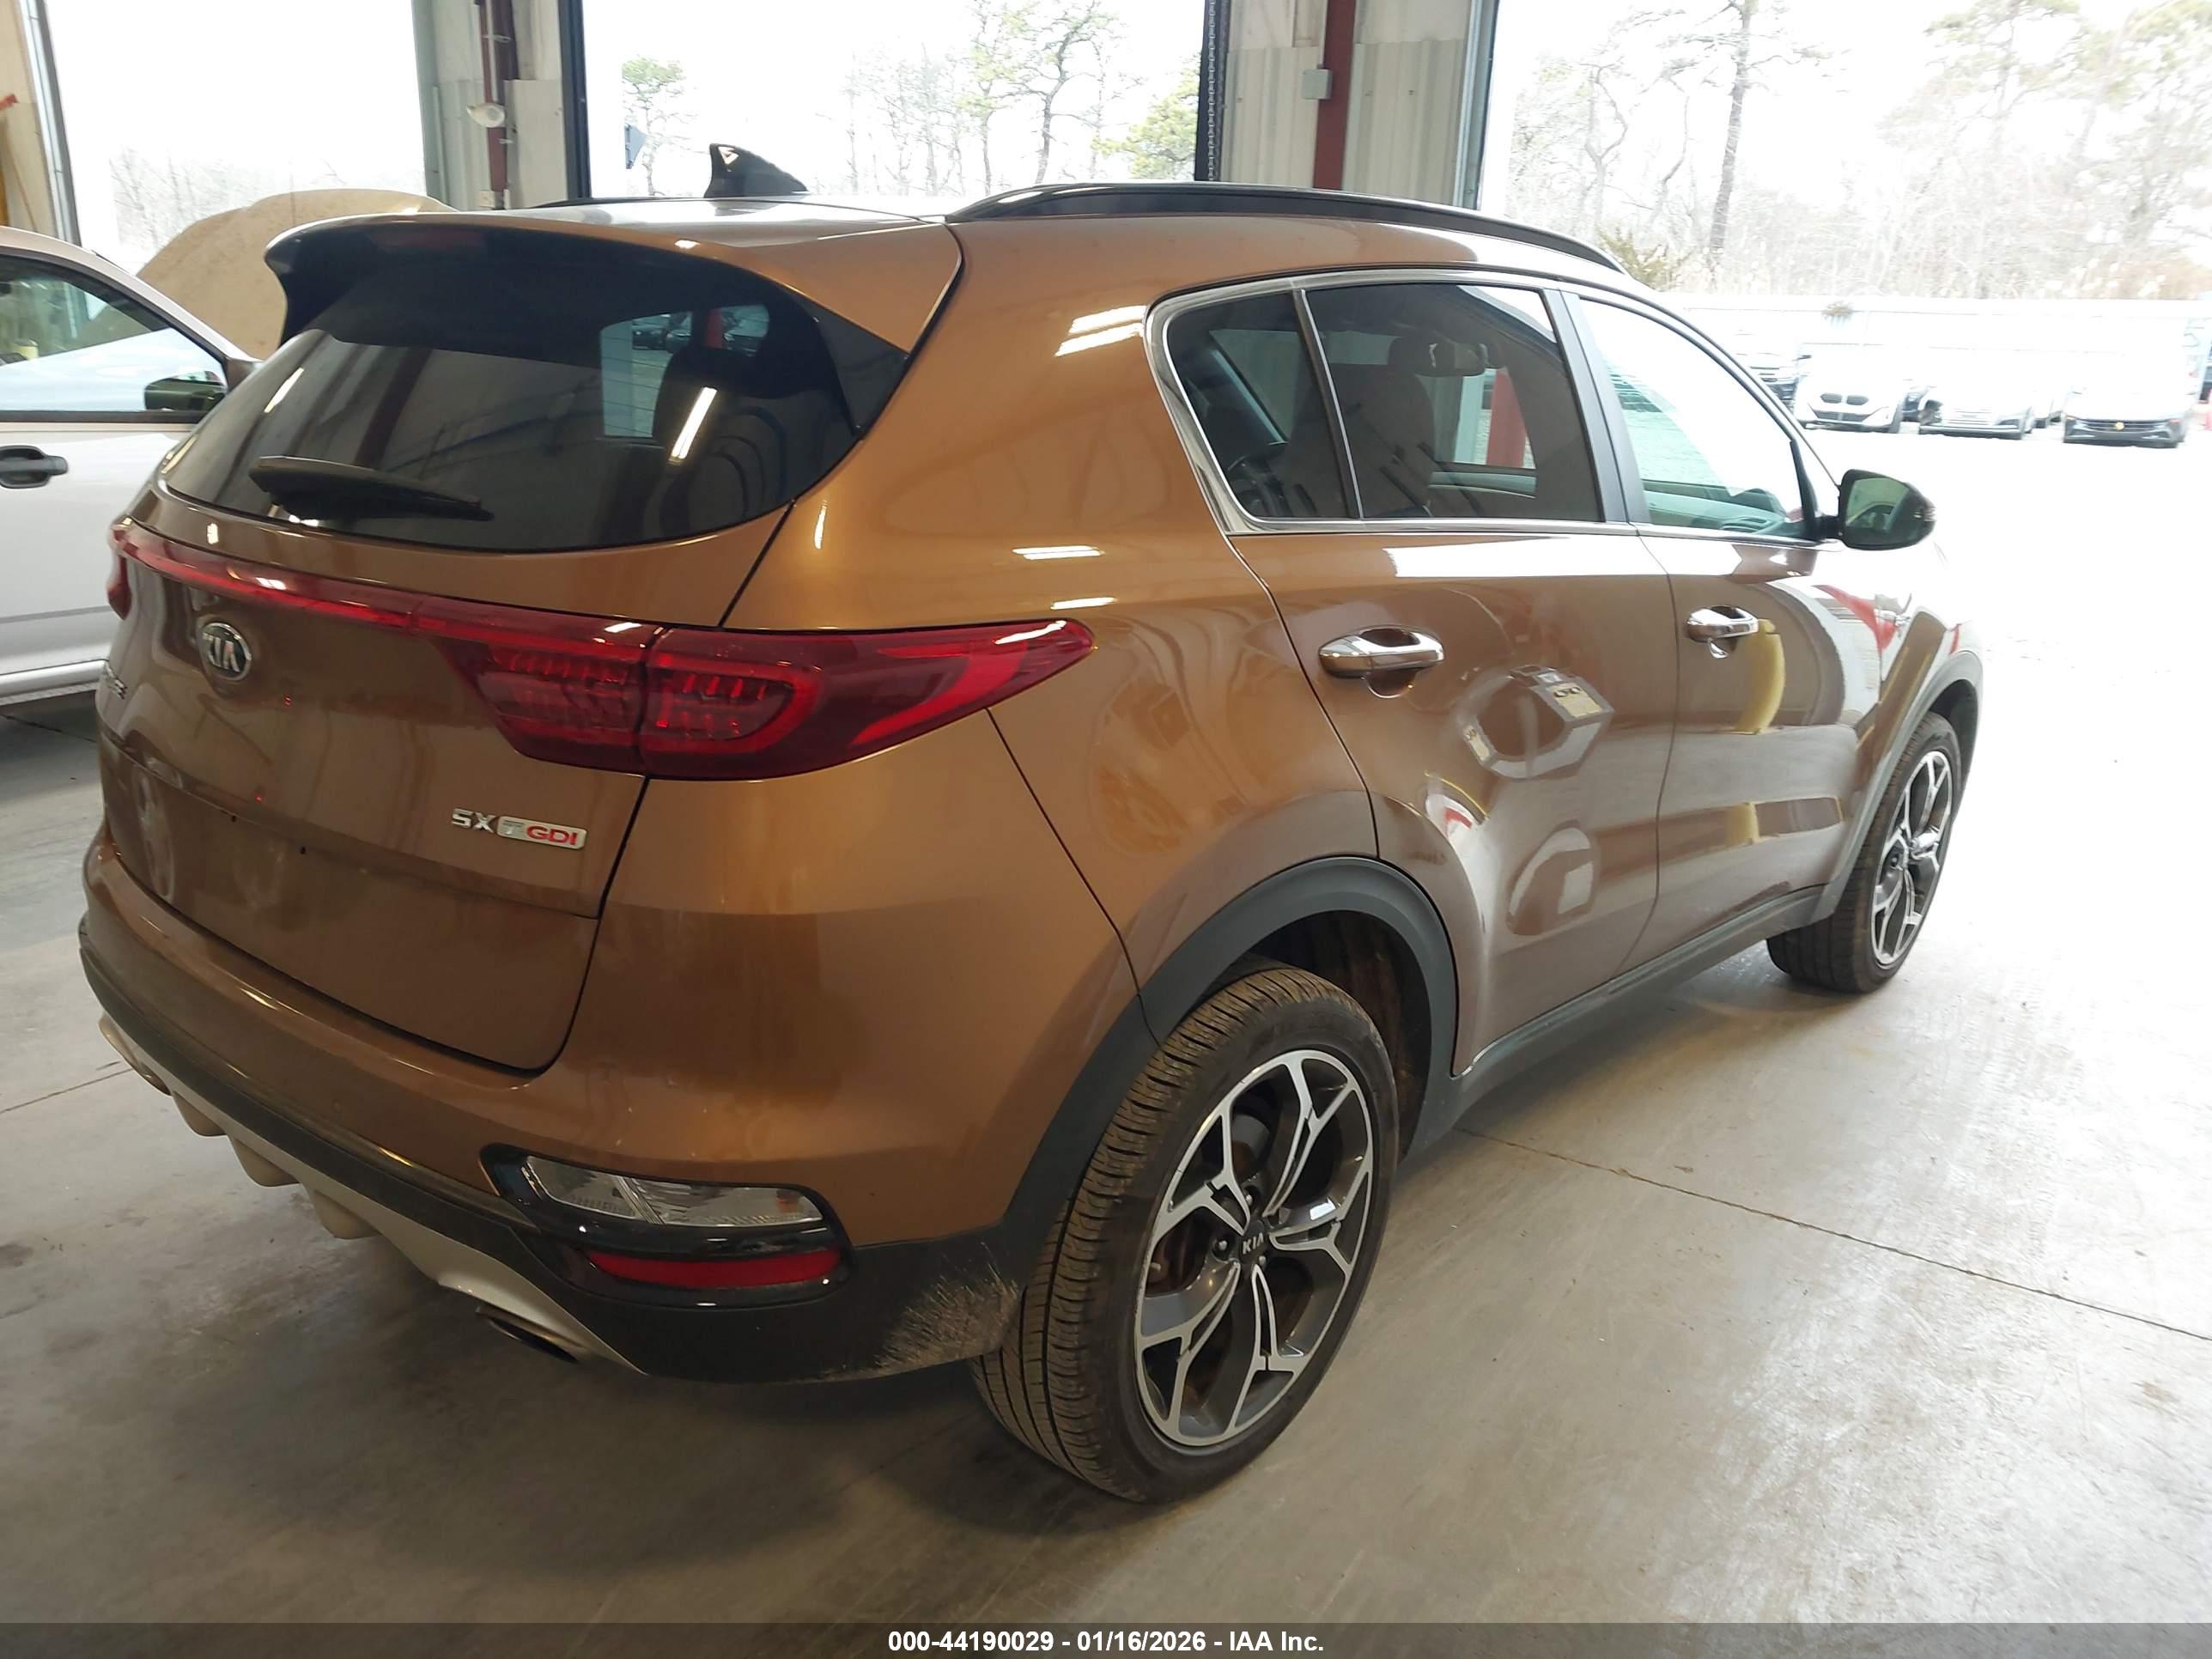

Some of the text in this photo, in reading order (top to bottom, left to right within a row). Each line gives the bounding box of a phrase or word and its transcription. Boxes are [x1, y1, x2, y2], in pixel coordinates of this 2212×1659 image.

[202, 631, 241, 672] KIA
[451, 807, 495, 834] SX
[526, 823, 578, 846] GDI
[1242, 1231, 1264, 1255] KIA
